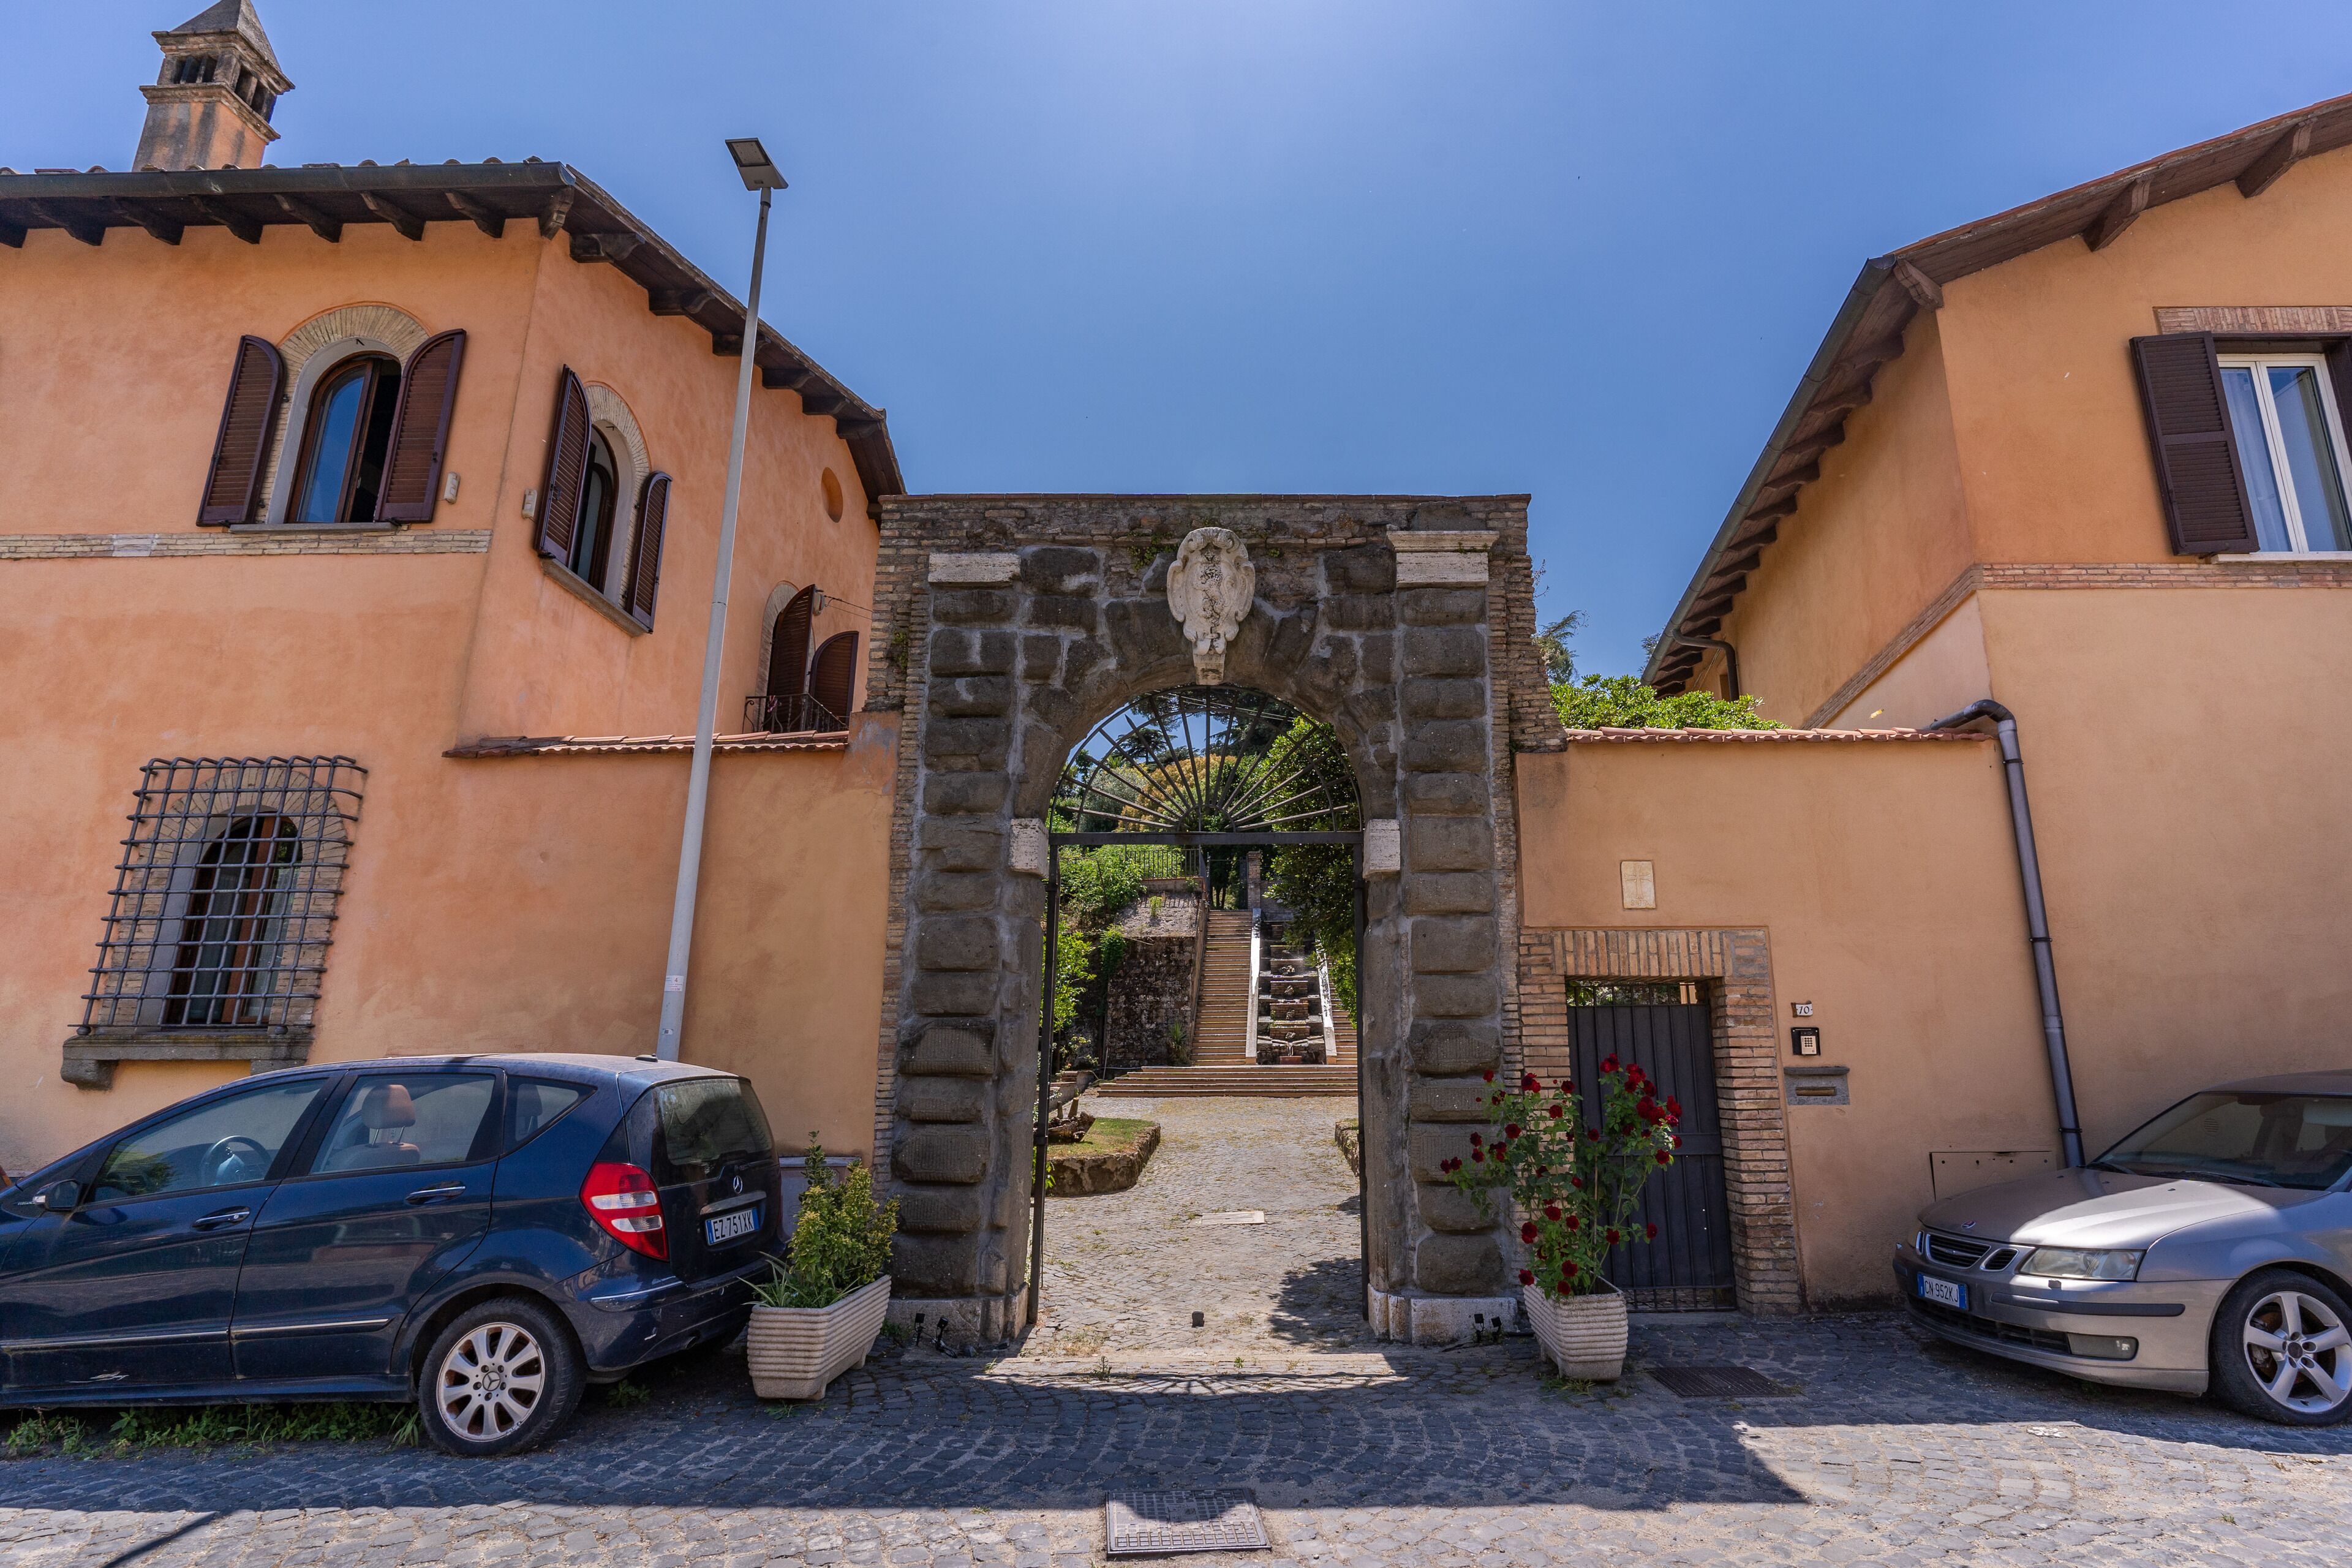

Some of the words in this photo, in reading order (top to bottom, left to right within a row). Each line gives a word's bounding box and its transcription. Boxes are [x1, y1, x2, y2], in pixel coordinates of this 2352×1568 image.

[713, 1219, 726, 1240] EZ
[726, 1212, 753, 1236] 751XK
[1924, 1280, 1934, 1296] CN
[1935, 1283, 1959, 1302] 952KJ
